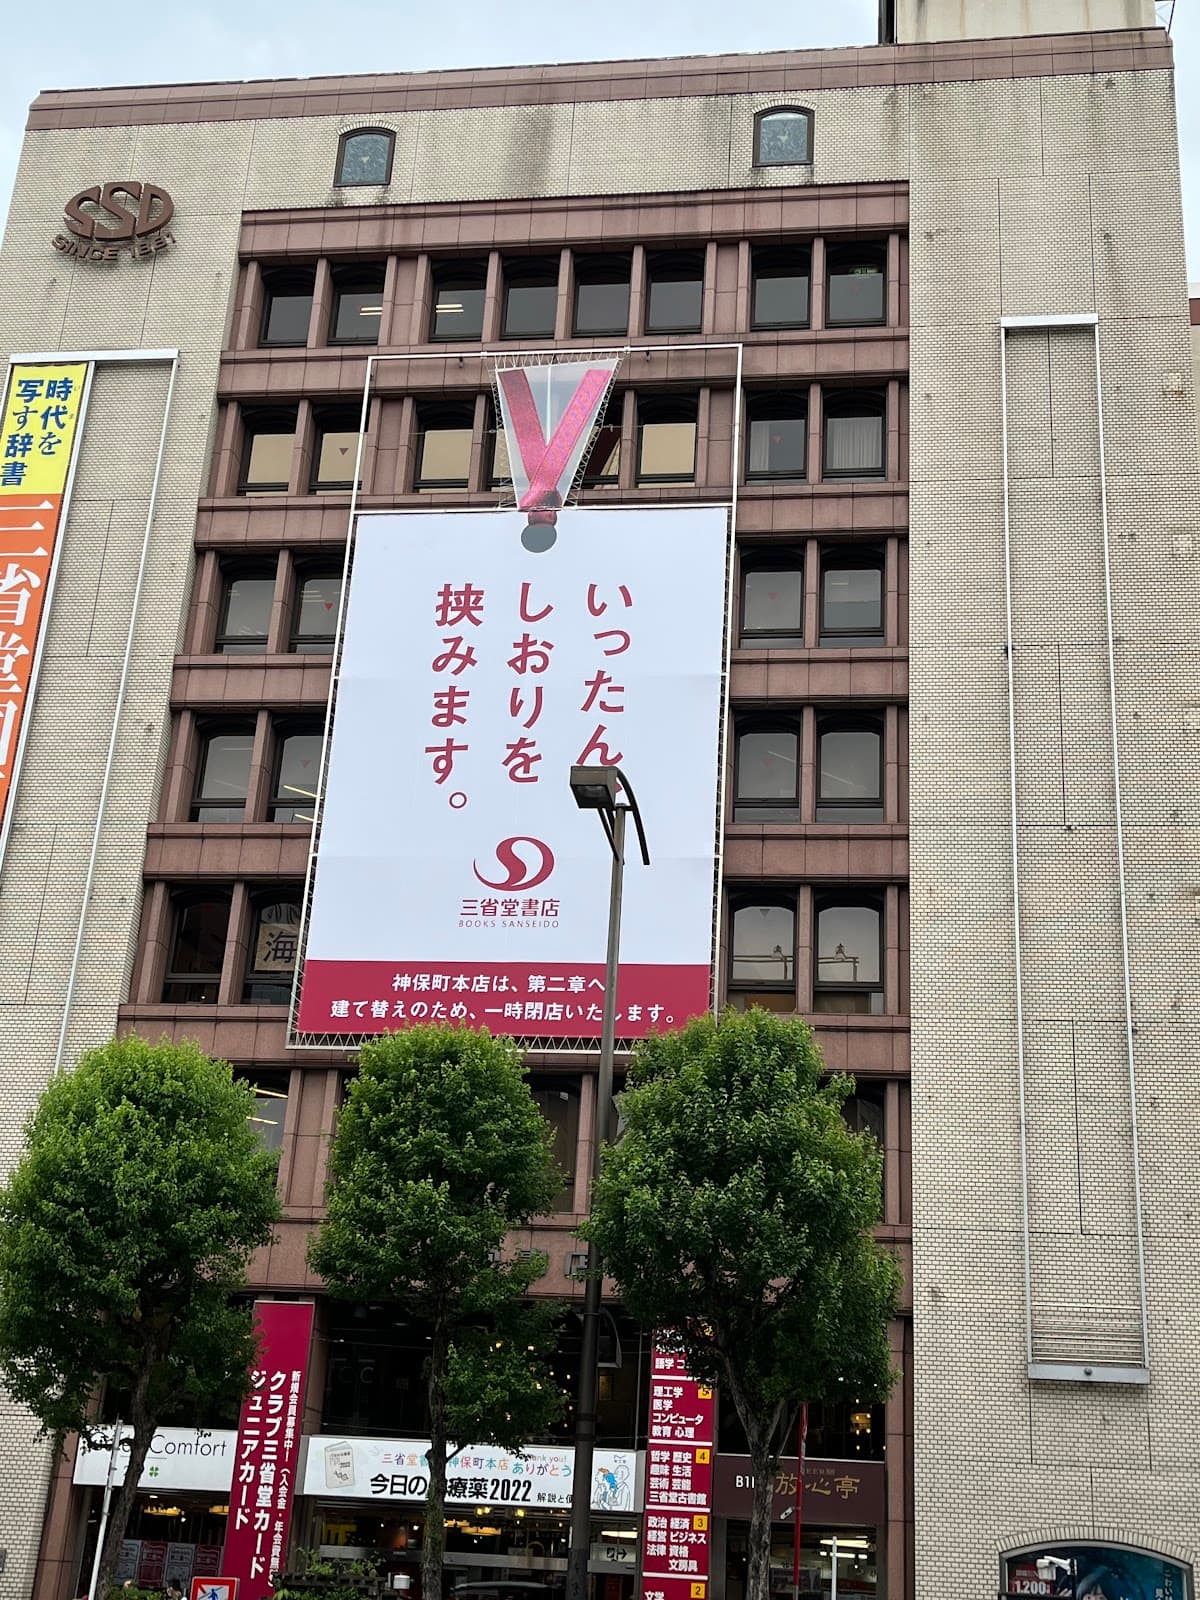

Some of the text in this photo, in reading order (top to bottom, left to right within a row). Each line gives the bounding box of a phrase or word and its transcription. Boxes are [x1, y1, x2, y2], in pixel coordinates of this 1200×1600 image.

[64, 181, 174, 241] SSD
[52, 232, 176, 260] SINCE 1881
[38, 377, 73, 456] 時代を
[0, 379, 44, 487] 写す辞書
[502, 582, 555, 783] しおりを
[575, 583, 633, 793] いったん
[424, 583, 485, 809] 挟みます。
[459, 898, 561, 917] 三省堂書店
[458, 920, 559, 928] BOOKS SANSEIDO
[391, 973, 606, 994] 神保町本店は、第二章へ
[653, 1386, 684, 1399] 理工学
[652, 1399, 674, 1411] 医学
[652, 1413, 704, 1426] コンピュータ
[651, 1425, 695, 1439] 教育 心理
[150, 1435, 227, 1457] Comfort
[235, 1370, 267, 1531] ジュニアカード
[651, 1450, 707, 1465] 哲学 歴史 4
[250, 1370, 287, 1580] クラブ三省堂カード
[512, 1462, 573, 1478] ありがとう
[672, 1465, 693, 1478] 生活
[370, 1473, 532, 1502] 今日の療薬2022
[649, 1477, 692, 1491] 芸術 芸能
[775, 1472, 861, 1500] 放心亭
[648, 1491, 708, 1506] 三省堂古書館
[647, 1516, 704, 1531] 政治 経済 3
[647, 1530, 707, 1545] 経営 ビジネス
[646, 1544, 689, 1558] 法律 資格
[668, 1559, 698, 1573] 文房具
[695, 1586, 702, 1596] 2
